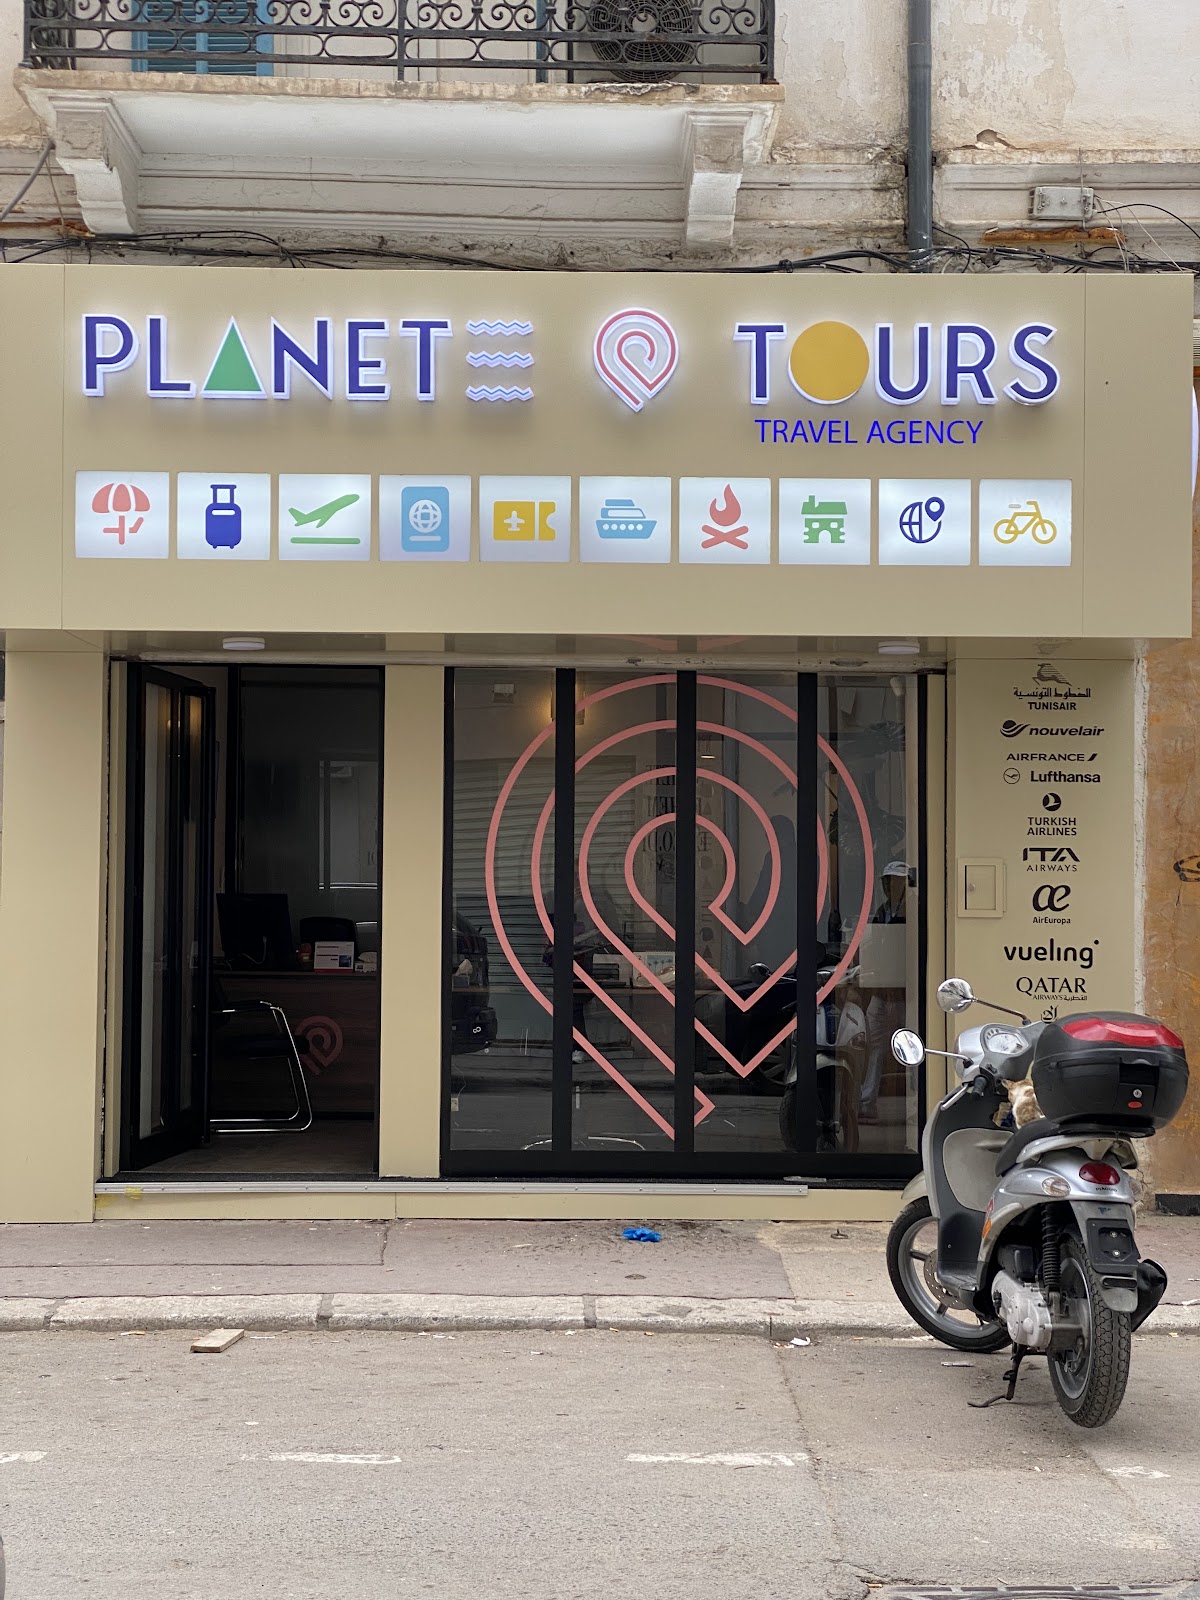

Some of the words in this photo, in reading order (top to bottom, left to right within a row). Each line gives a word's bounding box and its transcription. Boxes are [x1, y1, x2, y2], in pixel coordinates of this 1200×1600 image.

[733, 320, 1061, 406] TOURS
[754, 419, 858, 444] TRAVEL
[866, 420, 984, 444] AGENCY
[1013, 687, 1052, 700] التونسية
[1053, 687, 1091, 700] الخطوط
[1027, 701, 1077, 711] TUNISAIR
[1029, 724, 1105, 737] nouvelair
[1006, 752, 1085, 762] AIRFRANCE
[1030, 770, 1101, 783] Lufthansa
[1027, 816, 1077, 826] TURKISH
[1026, 827, 1077, 836] AIRLINES
[1022, 847, 1081, 862] ITA
[1026, 864, 1078, 872] AIRWAYS
[1032, 916, 1071, 925] AirEuropa
[1003, 938, 1100, 969] vueling
[1015, 976, 1087, 997] QATAR
